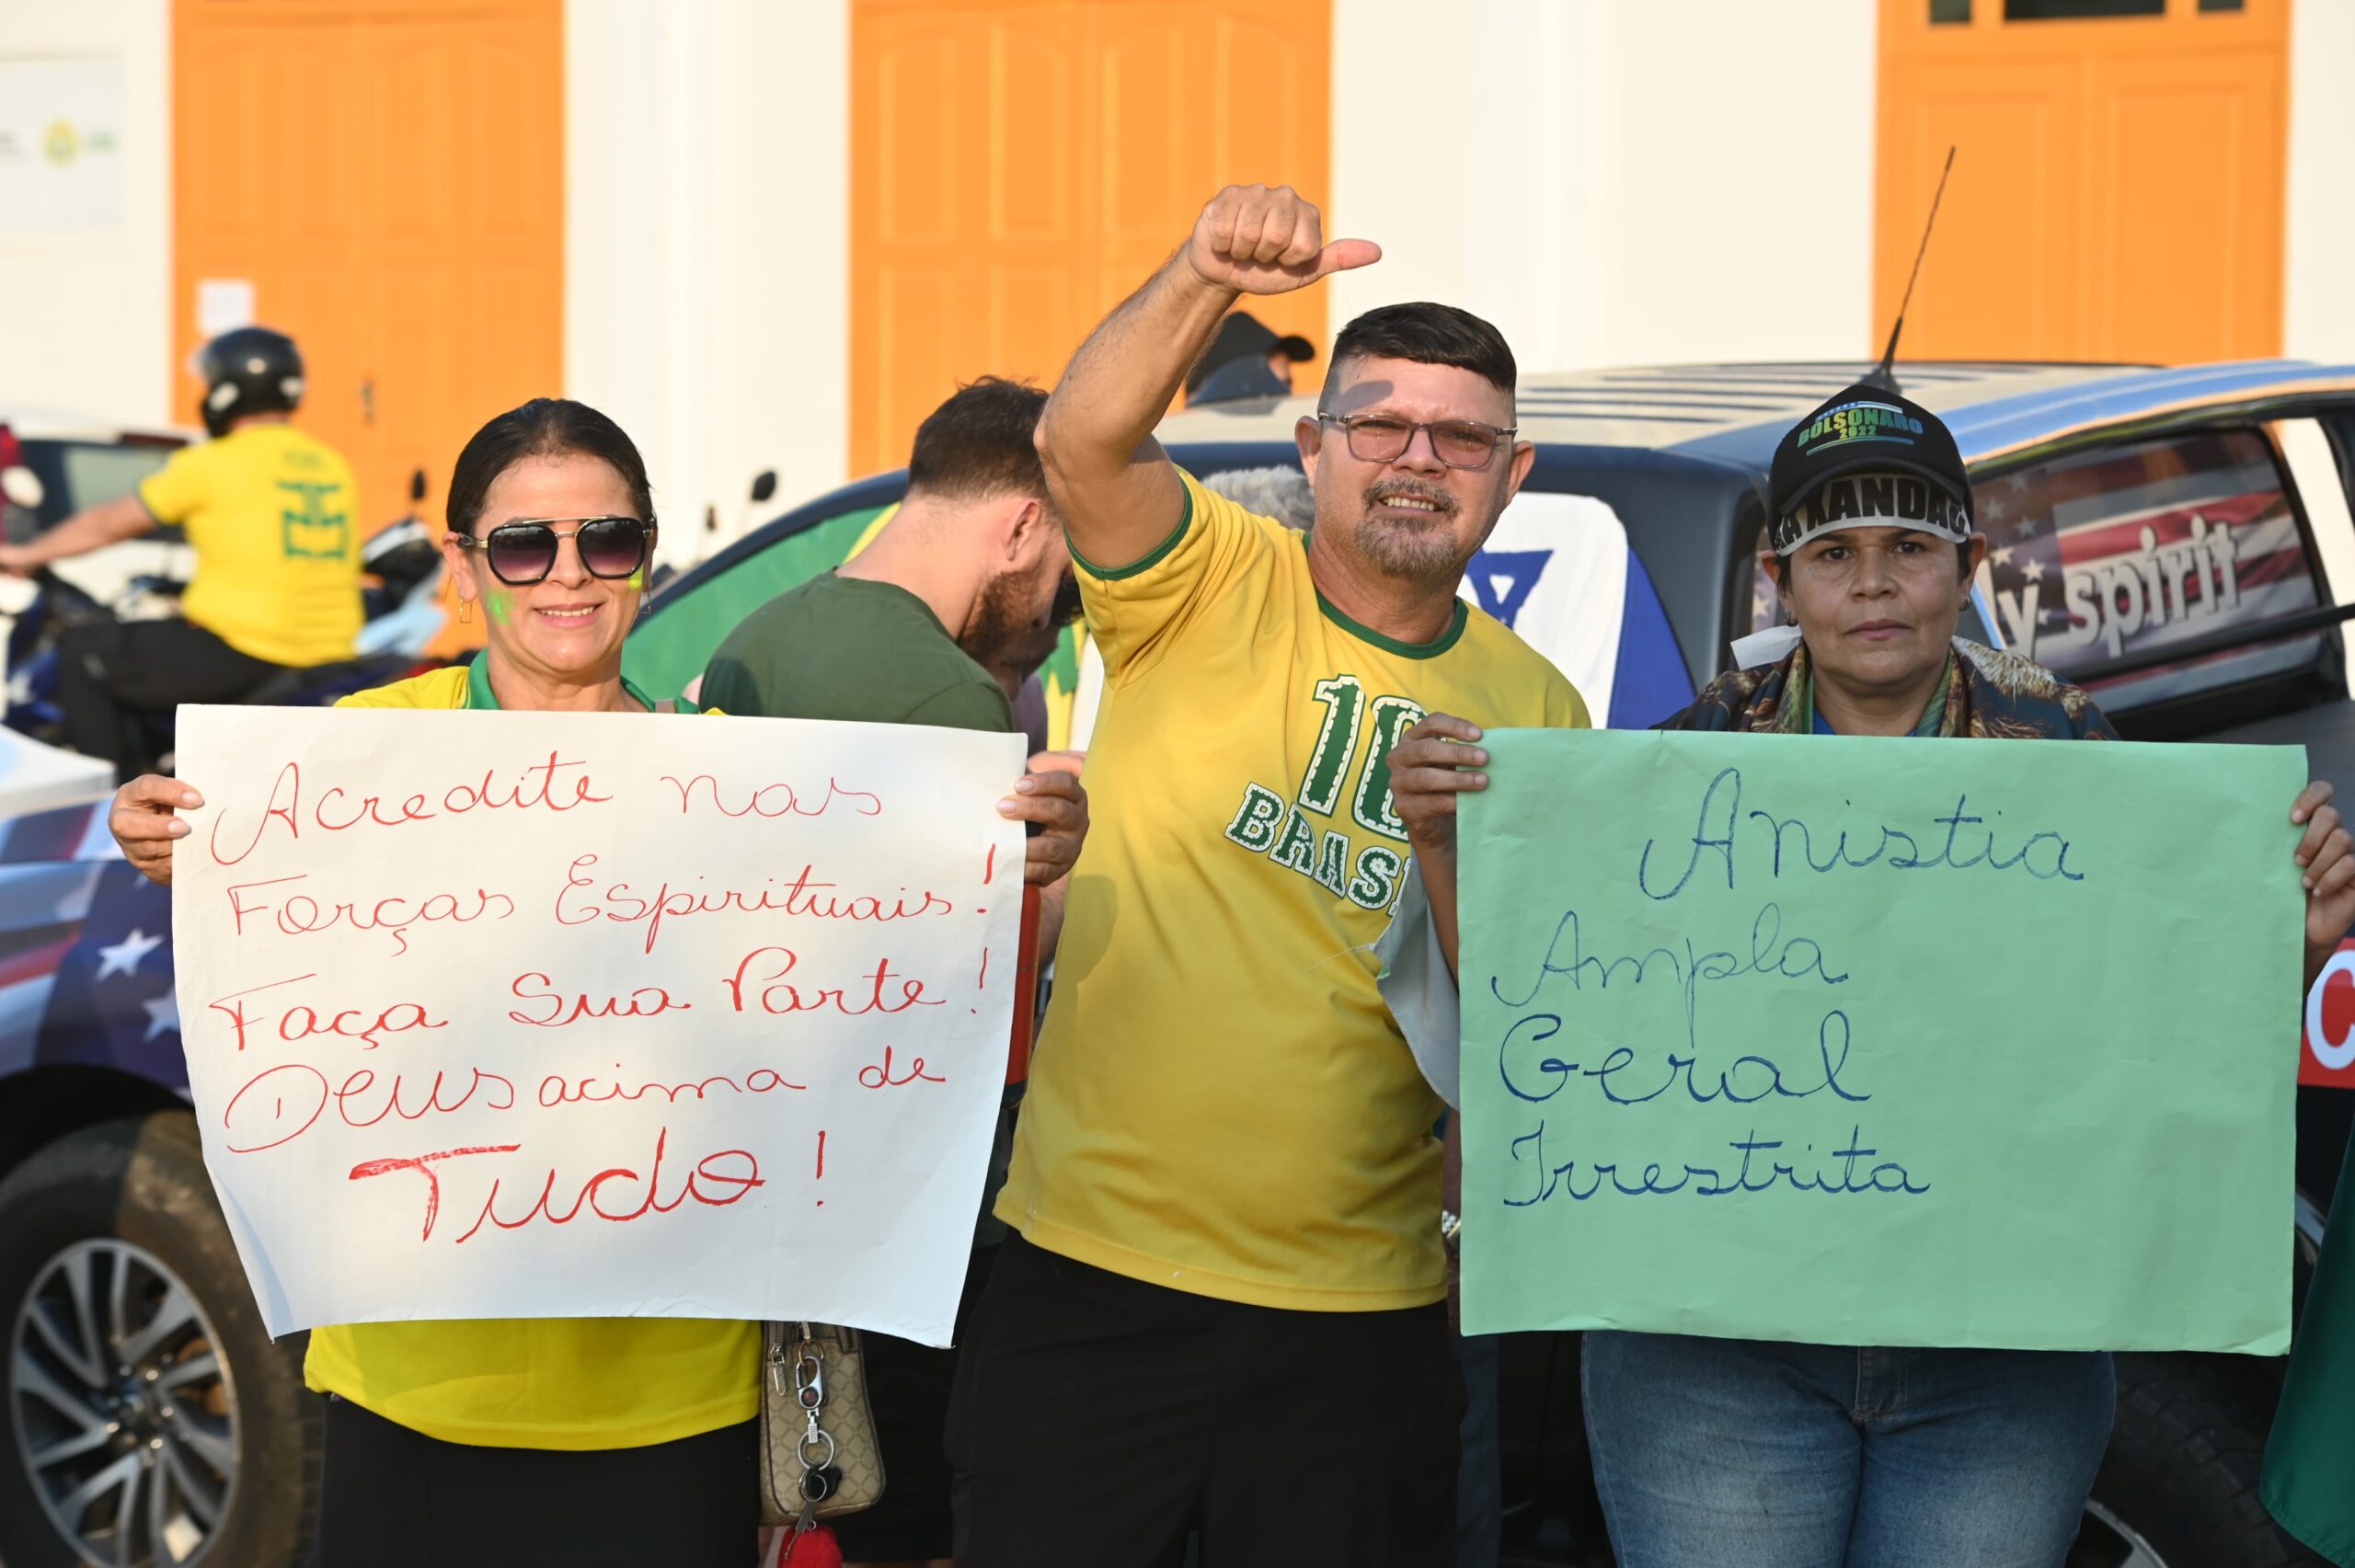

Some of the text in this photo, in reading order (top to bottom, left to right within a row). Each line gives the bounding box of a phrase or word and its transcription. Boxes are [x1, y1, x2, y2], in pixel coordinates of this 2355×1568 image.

[1797, 408, 1924, 448] BOLSONARO
[1840, 425, 1878, 439] 2022
[2066, 513, 2240, 658] spirit
[211, 750, 614, 865] Acredite
[1223, 782, 1412, 917] BRAS
[1638, 767, 2085, 900] Anistia
[227, 874, 516, 957] Forças
[208, 972, 450, 1051] Faça
[508, 972, 692, 1027] Sua
[1490, 902, 1849, 1049] Ampla
[224, 1046, 947, 1153] Deus acima de
[1499, 1010, 1873, 1105] Geral
[1503, 1119, 1932, 1207] Irrestrita
